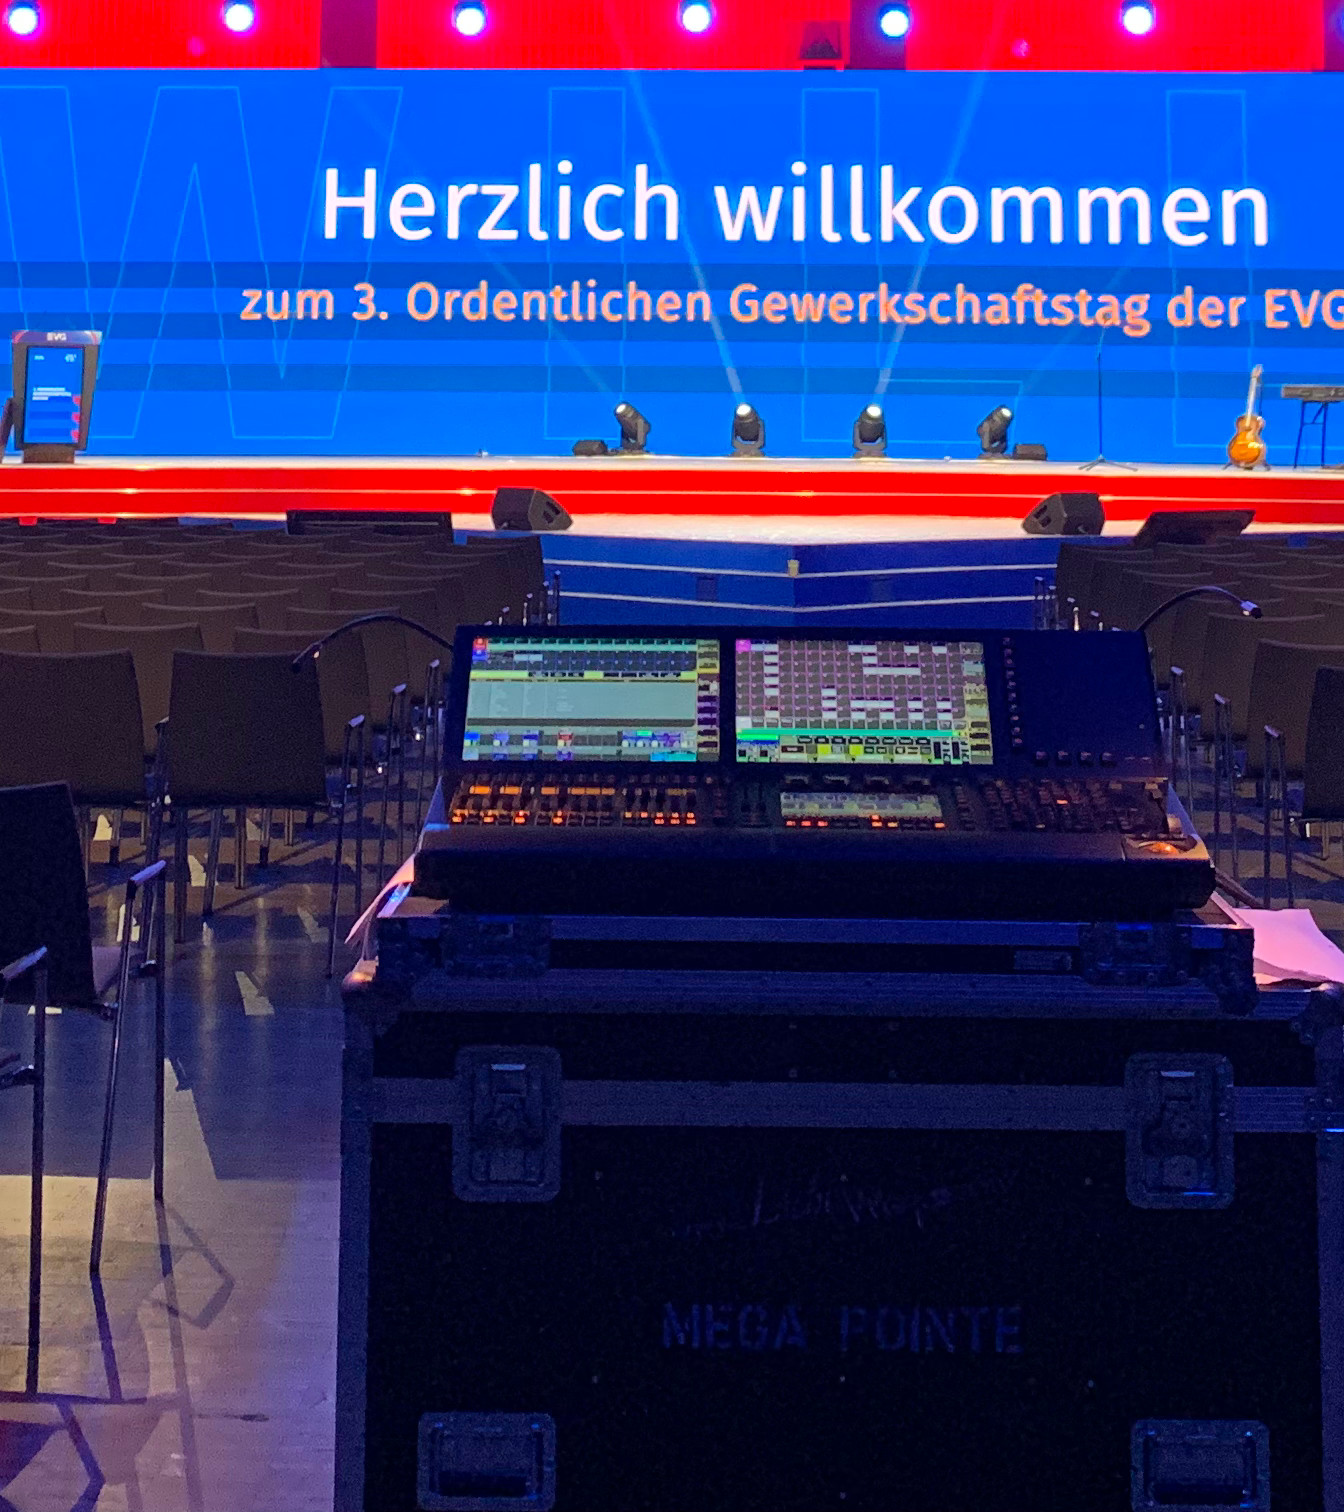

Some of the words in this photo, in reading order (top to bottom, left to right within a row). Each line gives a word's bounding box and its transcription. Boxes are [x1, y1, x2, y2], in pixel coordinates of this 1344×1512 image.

[323, 160, 679, 241] Herzlich
[713, 159, 1269, 247] willkommen
[239, 290, 334, 321] zum
[351, 283, 389, 322] 3.
[407, 279, 712, 324] Ordentlichen
[729, 281, 1150, 338] Gewerkschaftstag
[1166, 286, 1246, 329] der
[663, 1302, 807, 1349] MEGA
[840, 1305, 1025, 1354] POINTE
